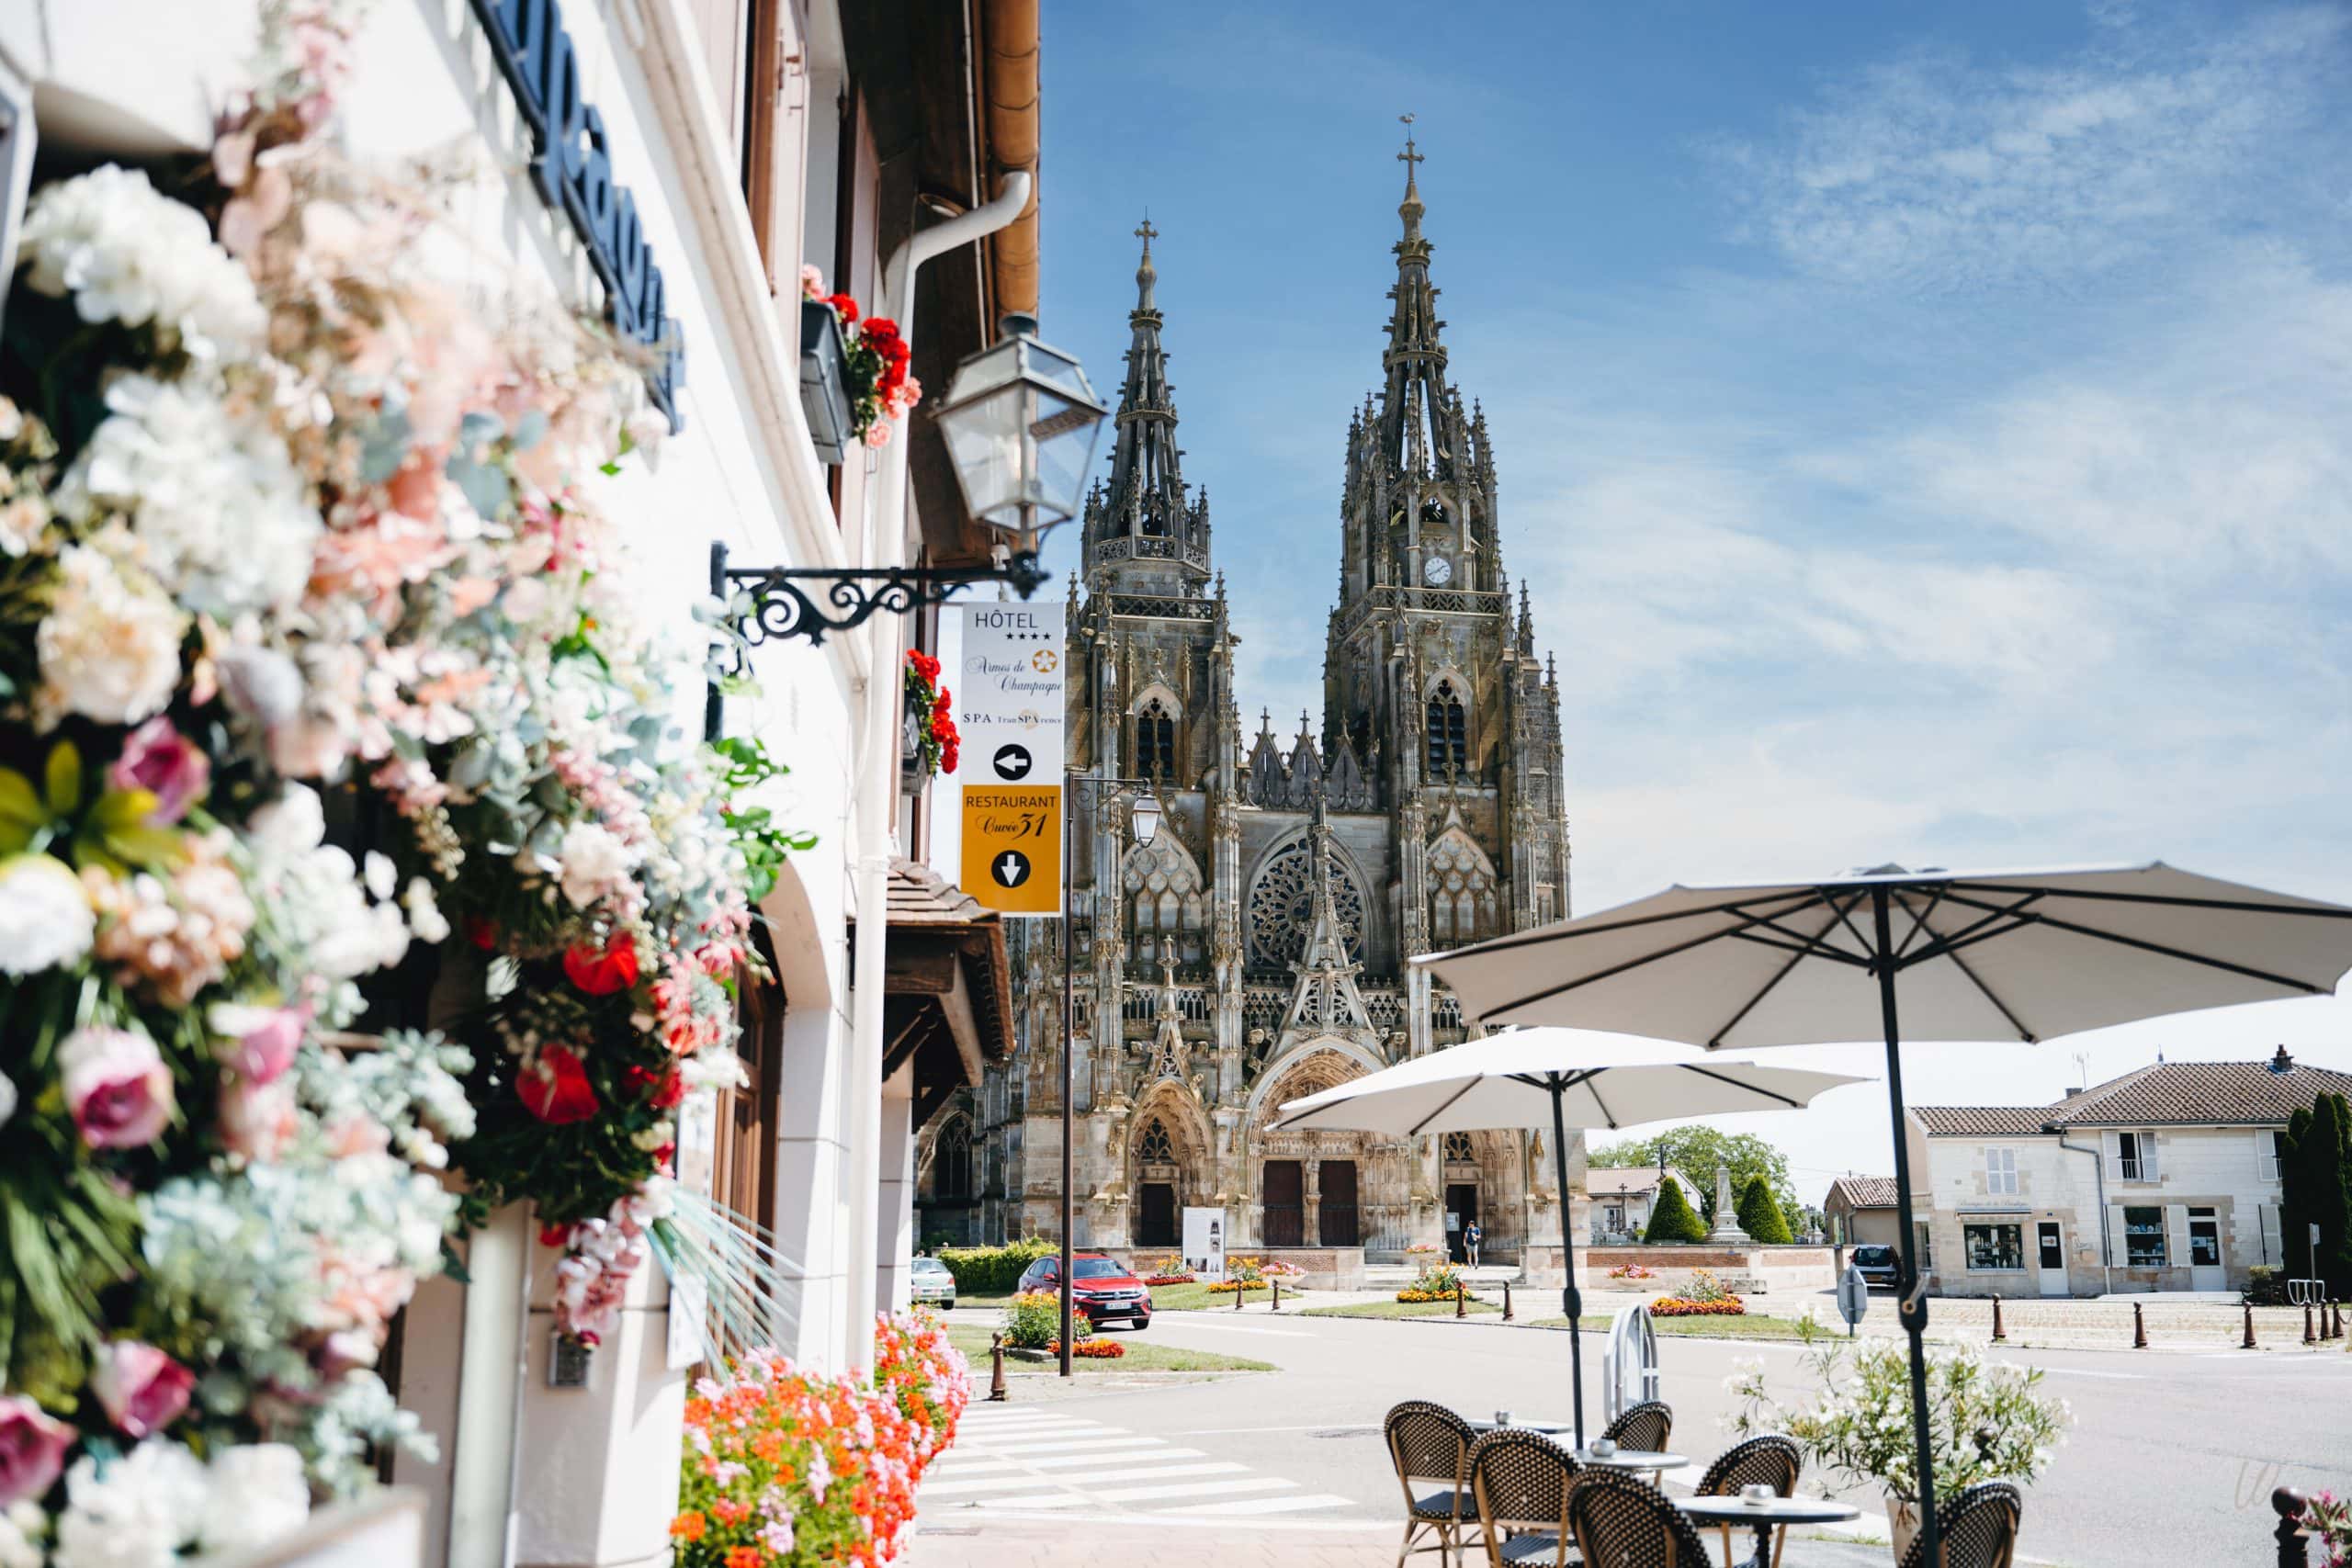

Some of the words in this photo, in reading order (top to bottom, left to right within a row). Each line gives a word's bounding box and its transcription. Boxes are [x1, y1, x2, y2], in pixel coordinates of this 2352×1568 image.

[976, 609, 1038, 628] HÔTEL
[966, 655, 1011, 675] Armes
[1013, 660, 1026, 672] de
[994, 674, 1063, 697] Champagne
[963, 713, 991, 724] SPA
[966, 795, 1057, 808] RESTAURANT
[1012, 813, 1047, 840] 31
